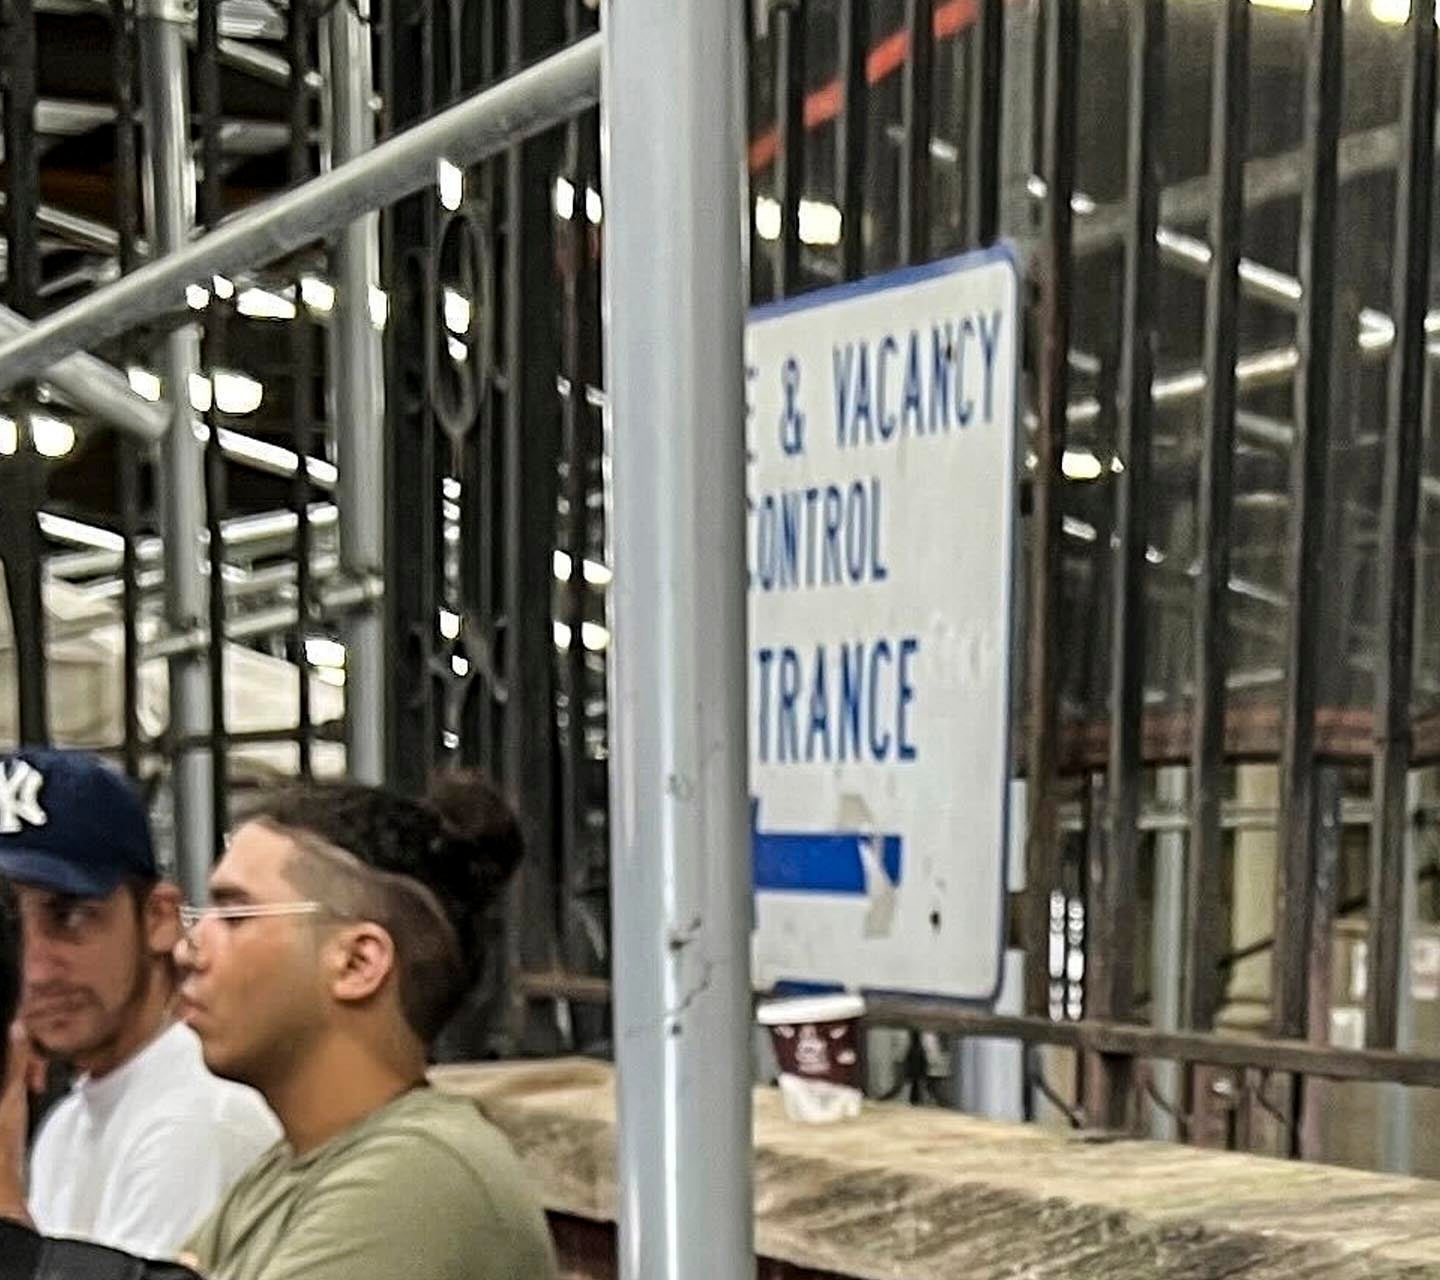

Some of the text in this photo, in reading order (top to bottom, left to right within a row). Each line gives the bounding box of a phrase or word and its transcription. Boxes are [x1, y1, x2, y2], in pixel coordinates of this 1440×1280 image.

[778, 356, 806, 455] &
[832, 309, 1002, 447] VACANCY
[747, 477, 887, 591] ONTROL
